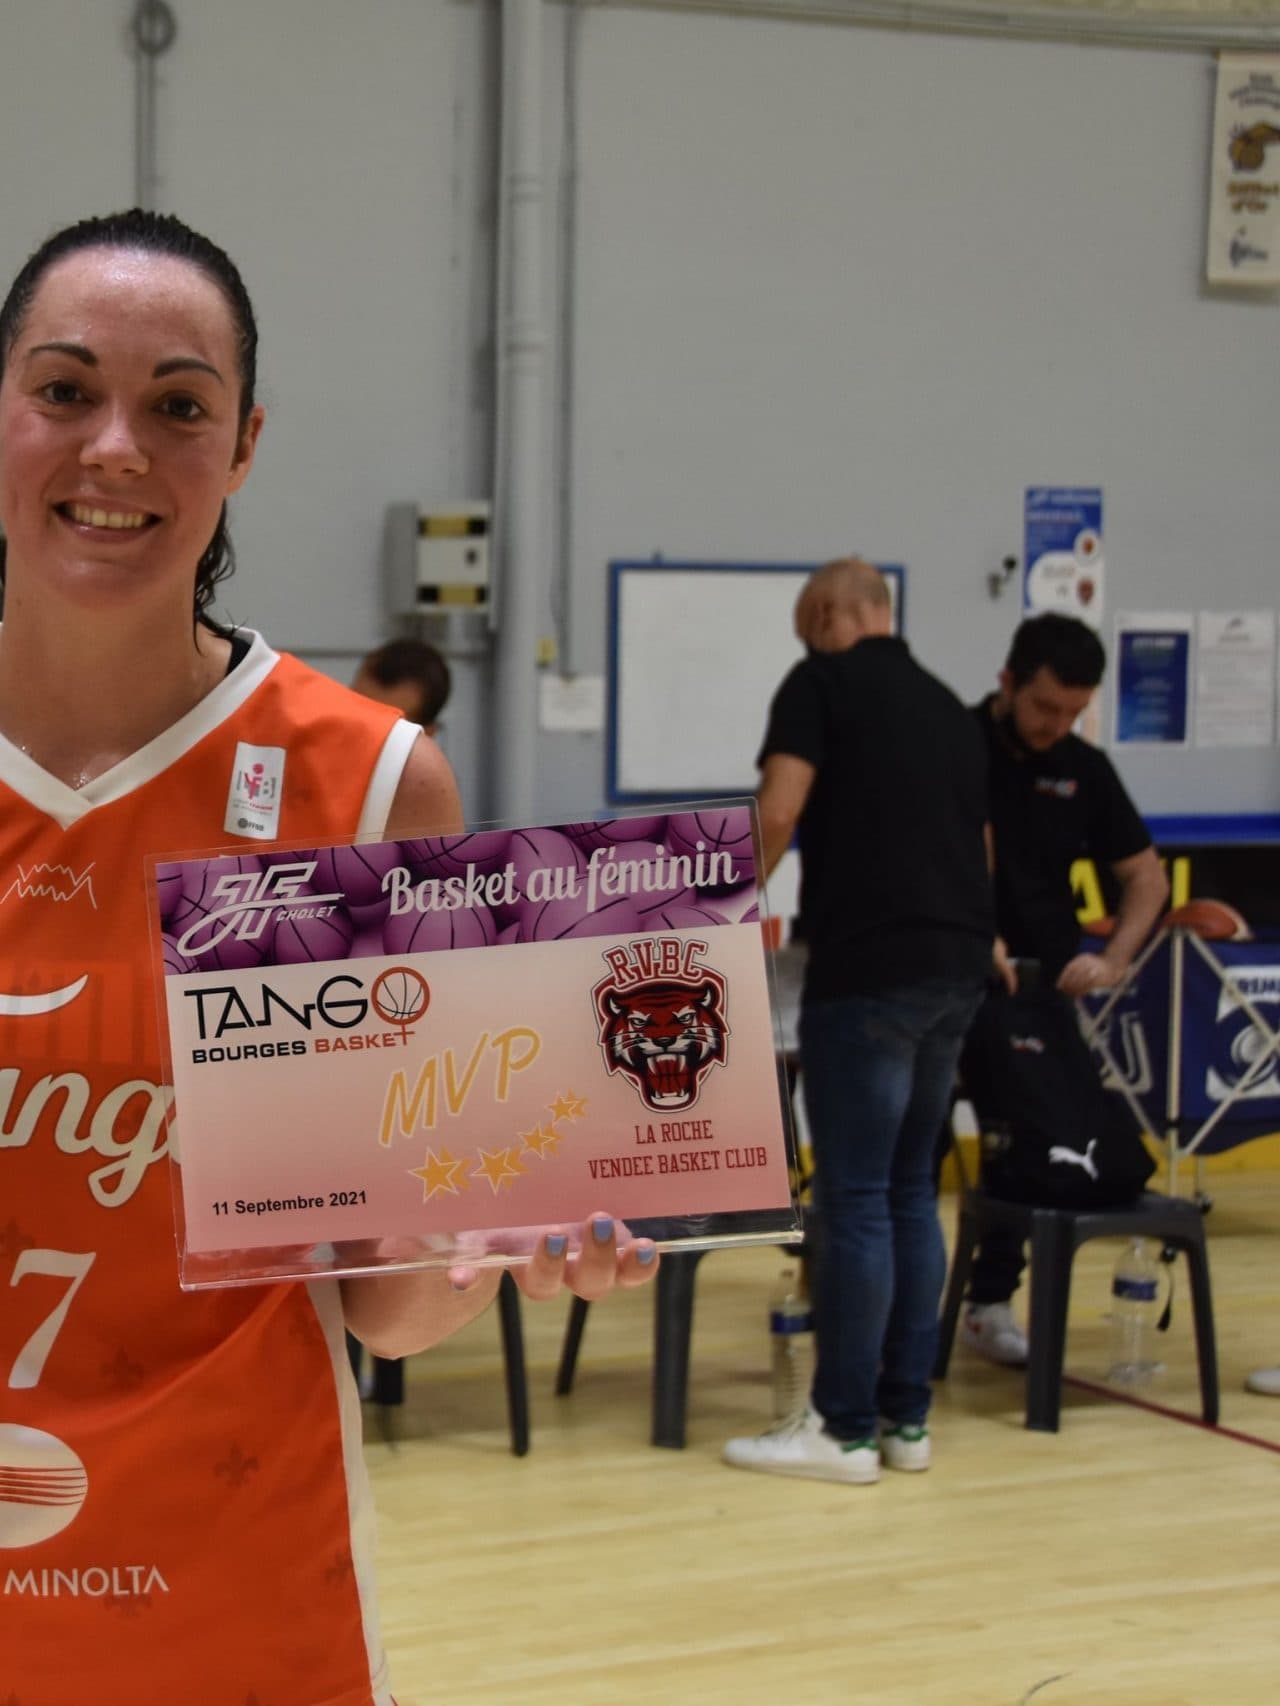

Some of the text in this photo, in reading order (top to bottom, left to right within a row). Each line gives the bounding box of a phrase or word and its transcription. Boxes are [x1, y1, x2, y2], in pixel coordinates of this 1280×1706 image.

[381, 841, 740, 916] Basket au féminin
[276, 905, 338, 922] CHOLET
[605, 938, 707, 985] RVBC
[184, 966, 430, 1040] TANGO
[192, 1023, 415, 1064] BOURGES BASKET
[379, 1026, 542, 1148] MVP
[635, 1120, 713, 1145] LA ROCHE
[588, 1147, 768, 1180] VENDEE BASKET CLUB
[212, 1190, 367, 1217] 11 Septembre 2021
[3, 1564, 170, 1597] MINOLTA
